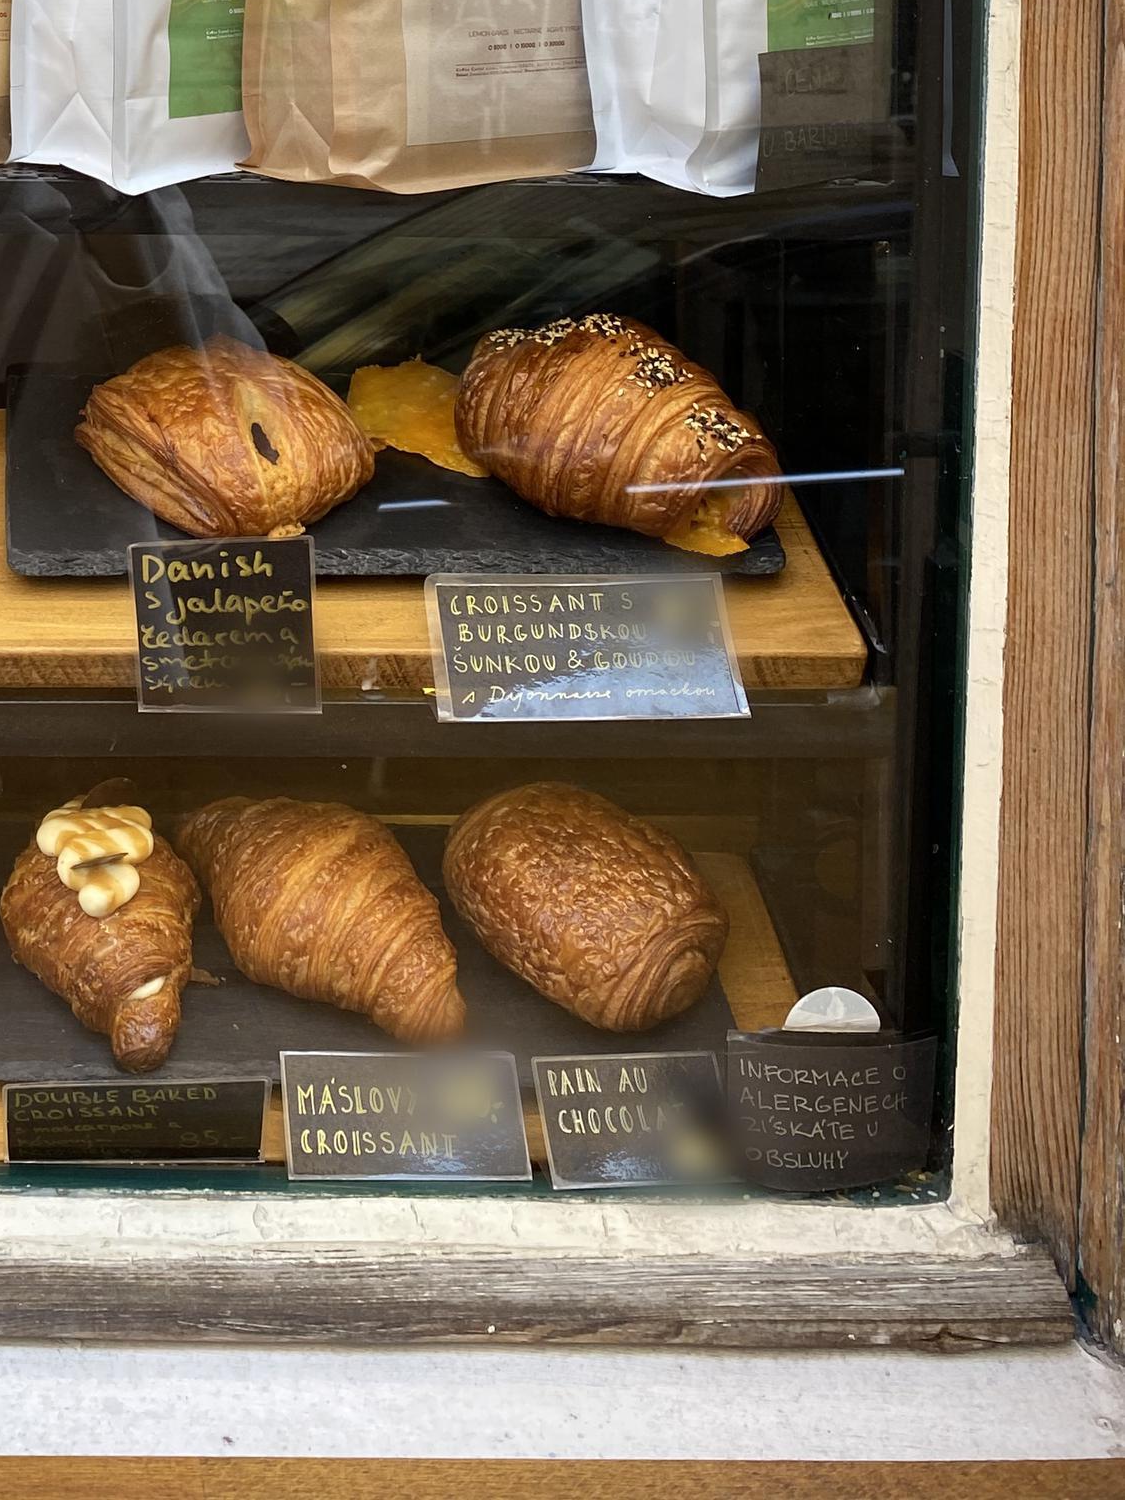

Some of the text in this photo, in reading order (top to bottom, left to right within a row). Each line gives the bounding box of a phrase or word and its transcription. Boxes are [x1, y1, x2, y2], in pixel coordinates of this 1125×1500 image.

[142, 551, 273, 583] Danish
[450, 592, 604, 616] CROISSANT
[453, 646, 556, 674] ŠUNKOU
[567, 649, 584, 668] &
[547, 1067, 648, 1097] PAIN AU
[739, 1058, 881, 1088] INFORMACE
[14, 1086, 217, 1108] DOUBLE BAKED
[739, 1086, 908, 1116] ALERGENECH
[13, 1104, 159, 1123] CROISSANT
[557, 1101, 685, 1134] CHOCOLA
[300, 1128, 459, 1158] CROISSANT
[745, 1147, 849, 1170] OBSLUHY
